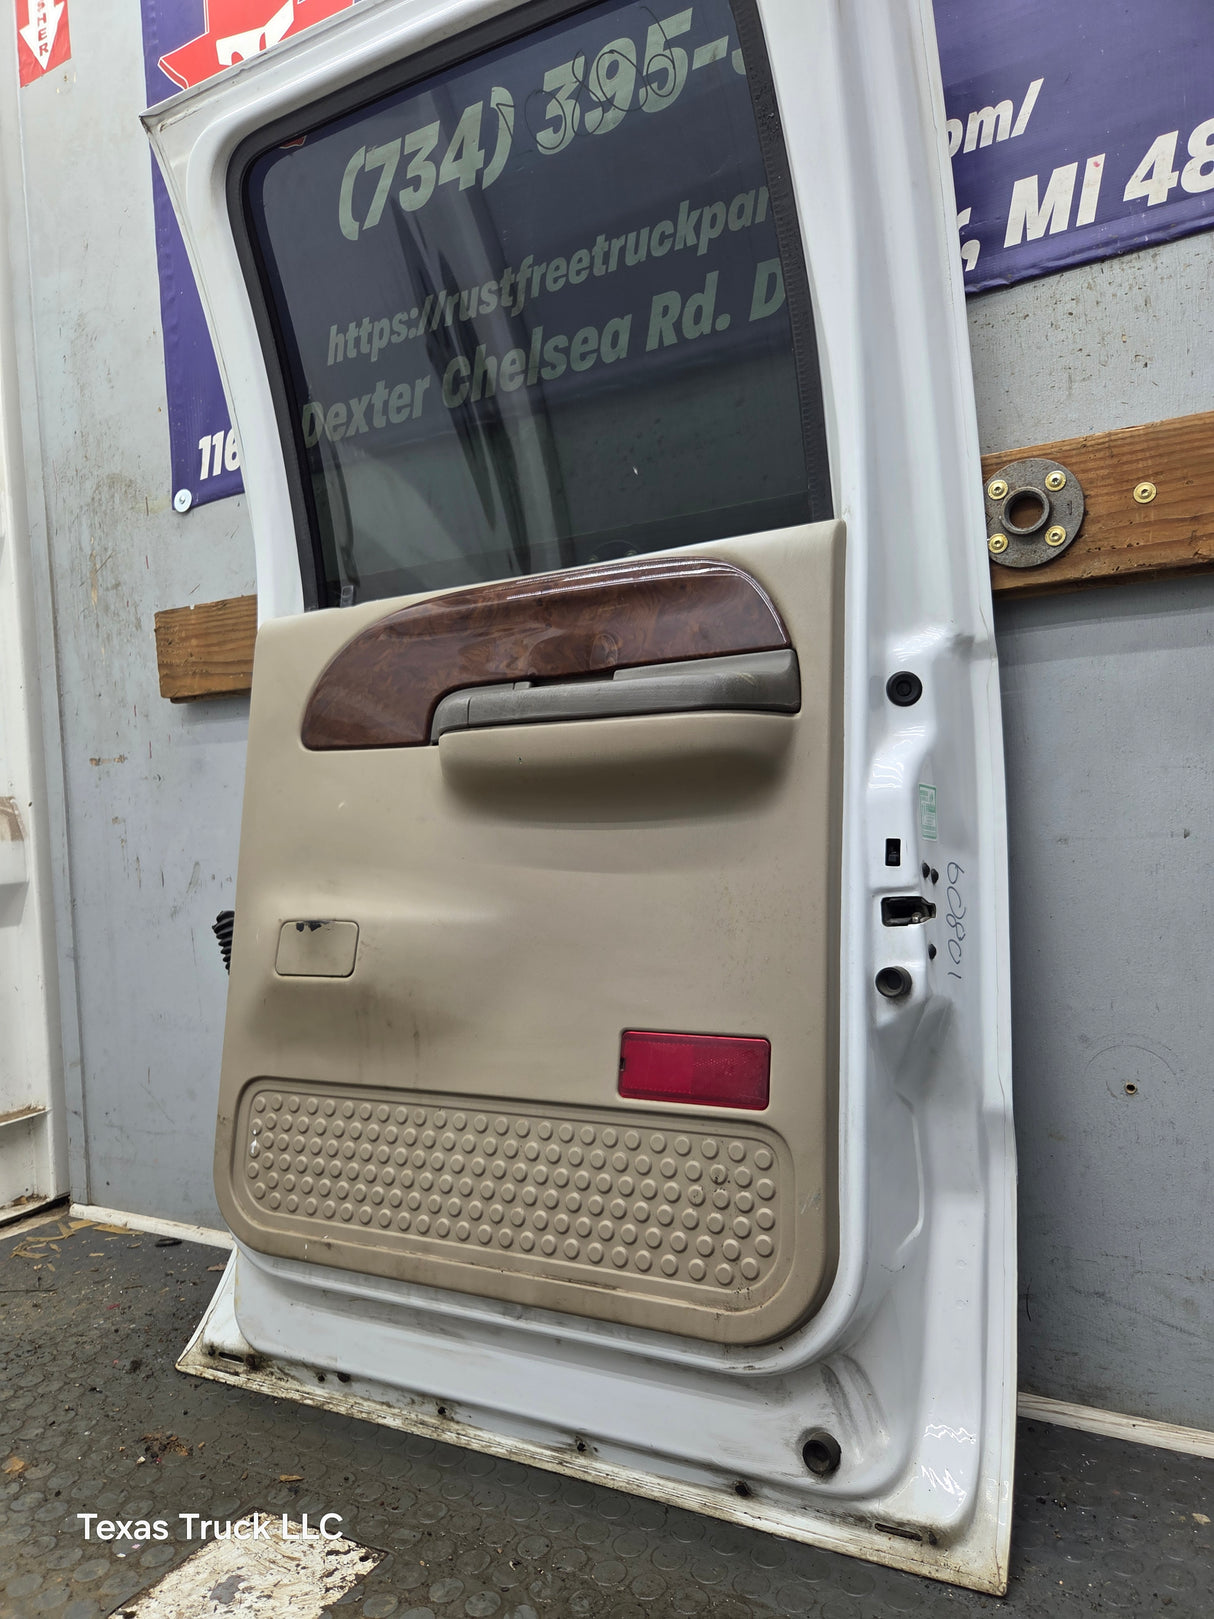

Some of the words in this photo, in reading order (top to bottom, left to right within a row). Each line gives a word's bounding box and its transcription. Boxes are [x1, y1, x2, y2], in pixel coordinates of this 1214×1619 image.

[339, 87, 515, 241] (734)
[301, 375, 431, 449] Dexter
[442, 313, 633, 408] Chelsea
[645, 270, 731, 352] Rd.
[1003, 153, 1106, 248] MI
